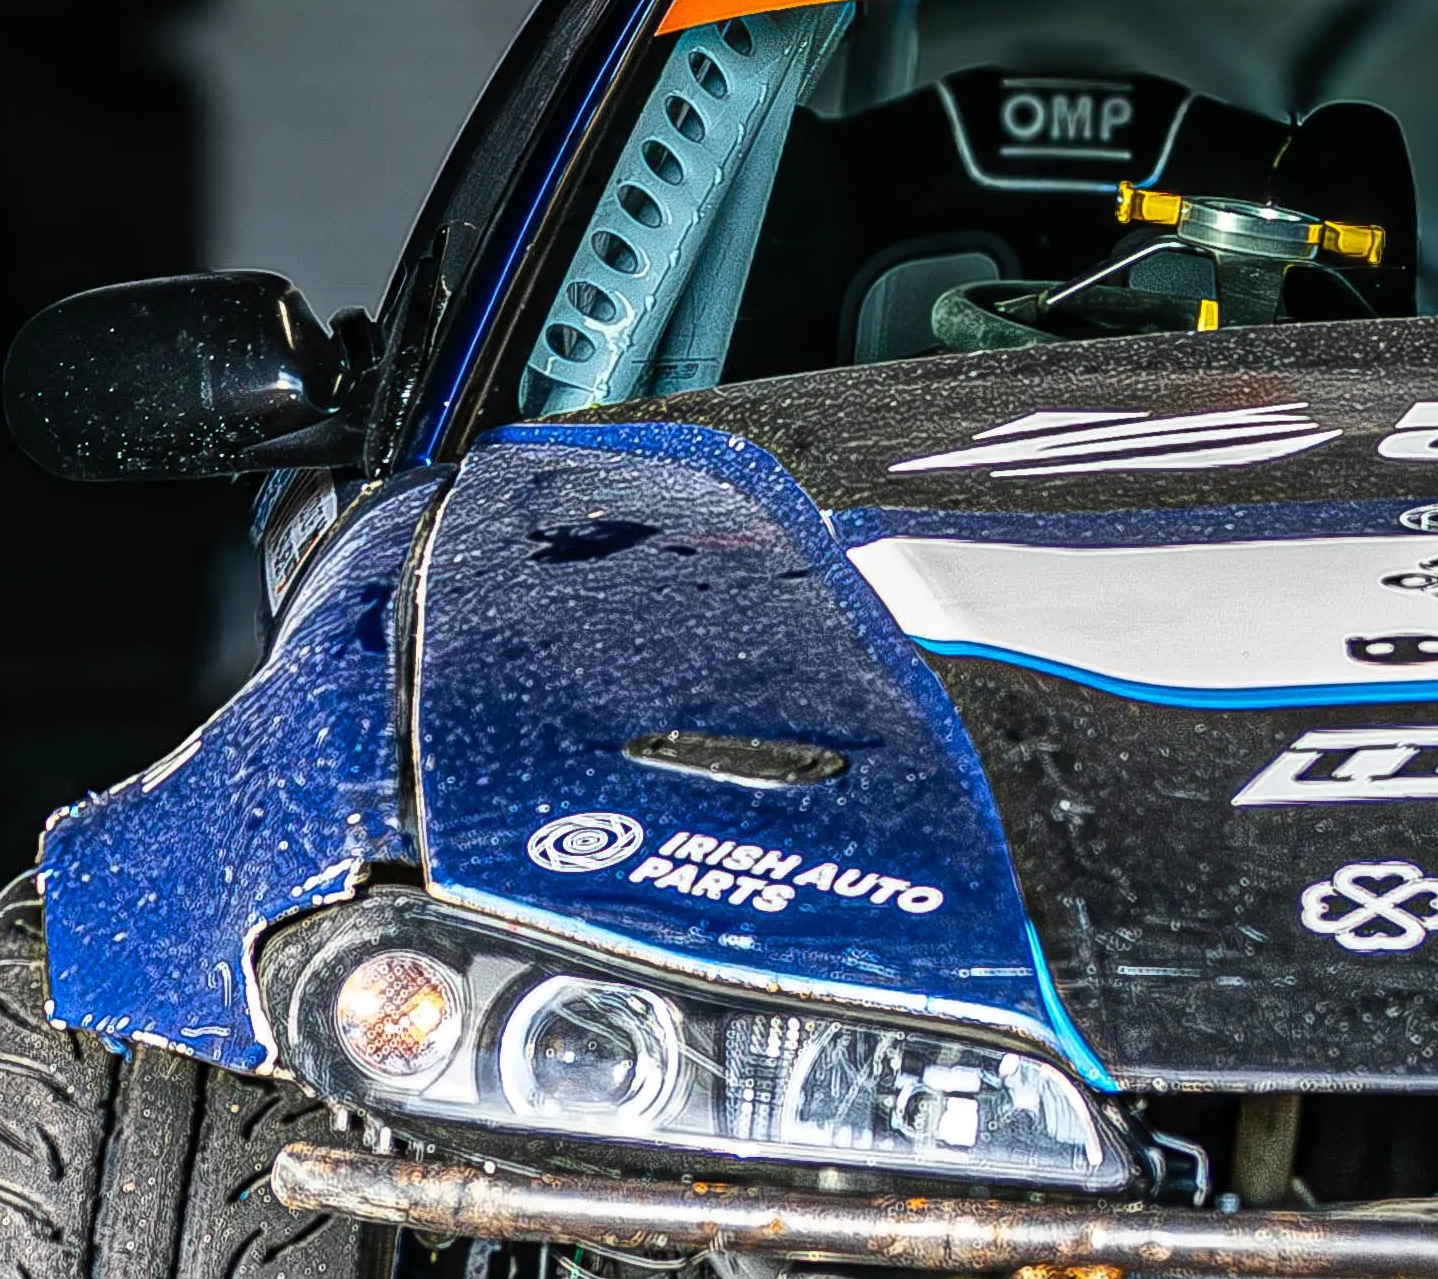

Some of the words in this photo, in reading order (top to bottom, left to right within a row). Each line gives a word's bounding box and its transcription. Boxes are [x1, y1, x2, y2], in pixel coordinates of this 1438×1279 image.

[1000, 93, 1134, 141] OMP
[628, 856, 796, 913] PARTS
[658, 832, 803, 880] IRISH
[792, 862, 945, 915] AUTO
